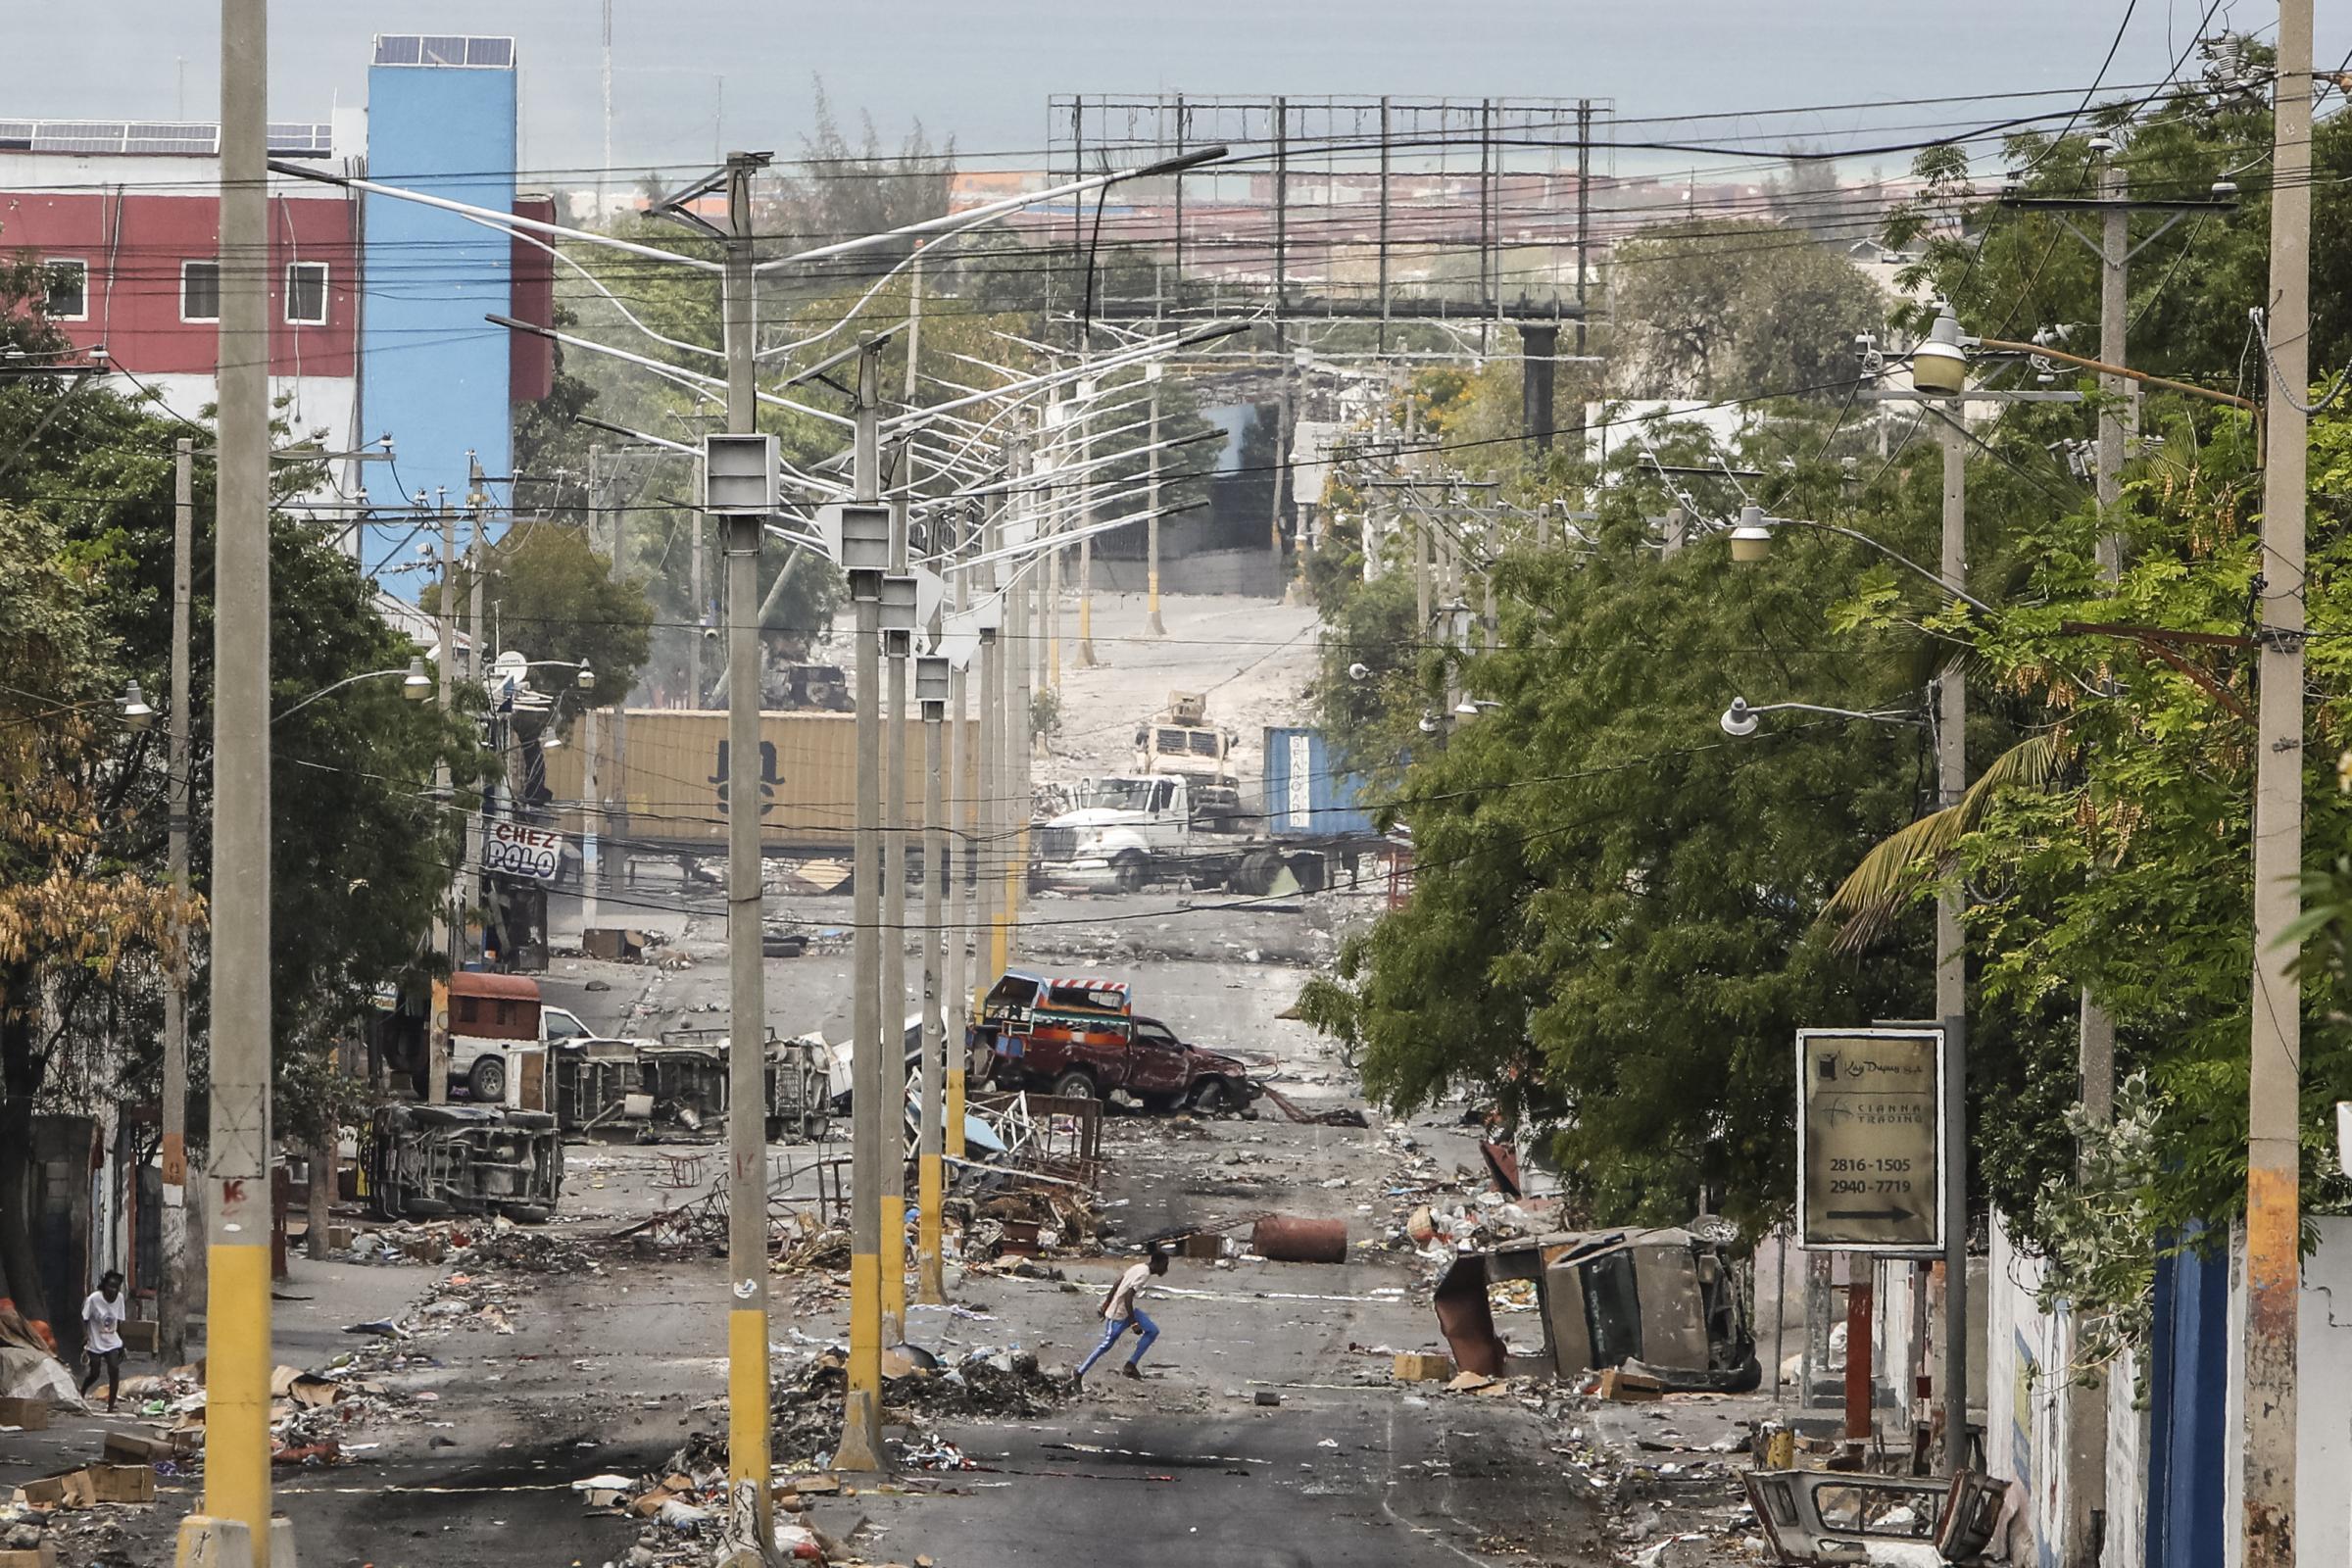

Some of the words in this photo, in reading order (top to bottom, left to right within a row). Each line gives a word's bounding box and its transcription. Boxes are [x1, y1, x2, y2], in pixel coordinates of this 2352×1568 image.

[496, 824, 556, 849] CHEZ
[487, 840, 555, 877] POLO
[1858, 1115, 1923, 1124] TRADING
